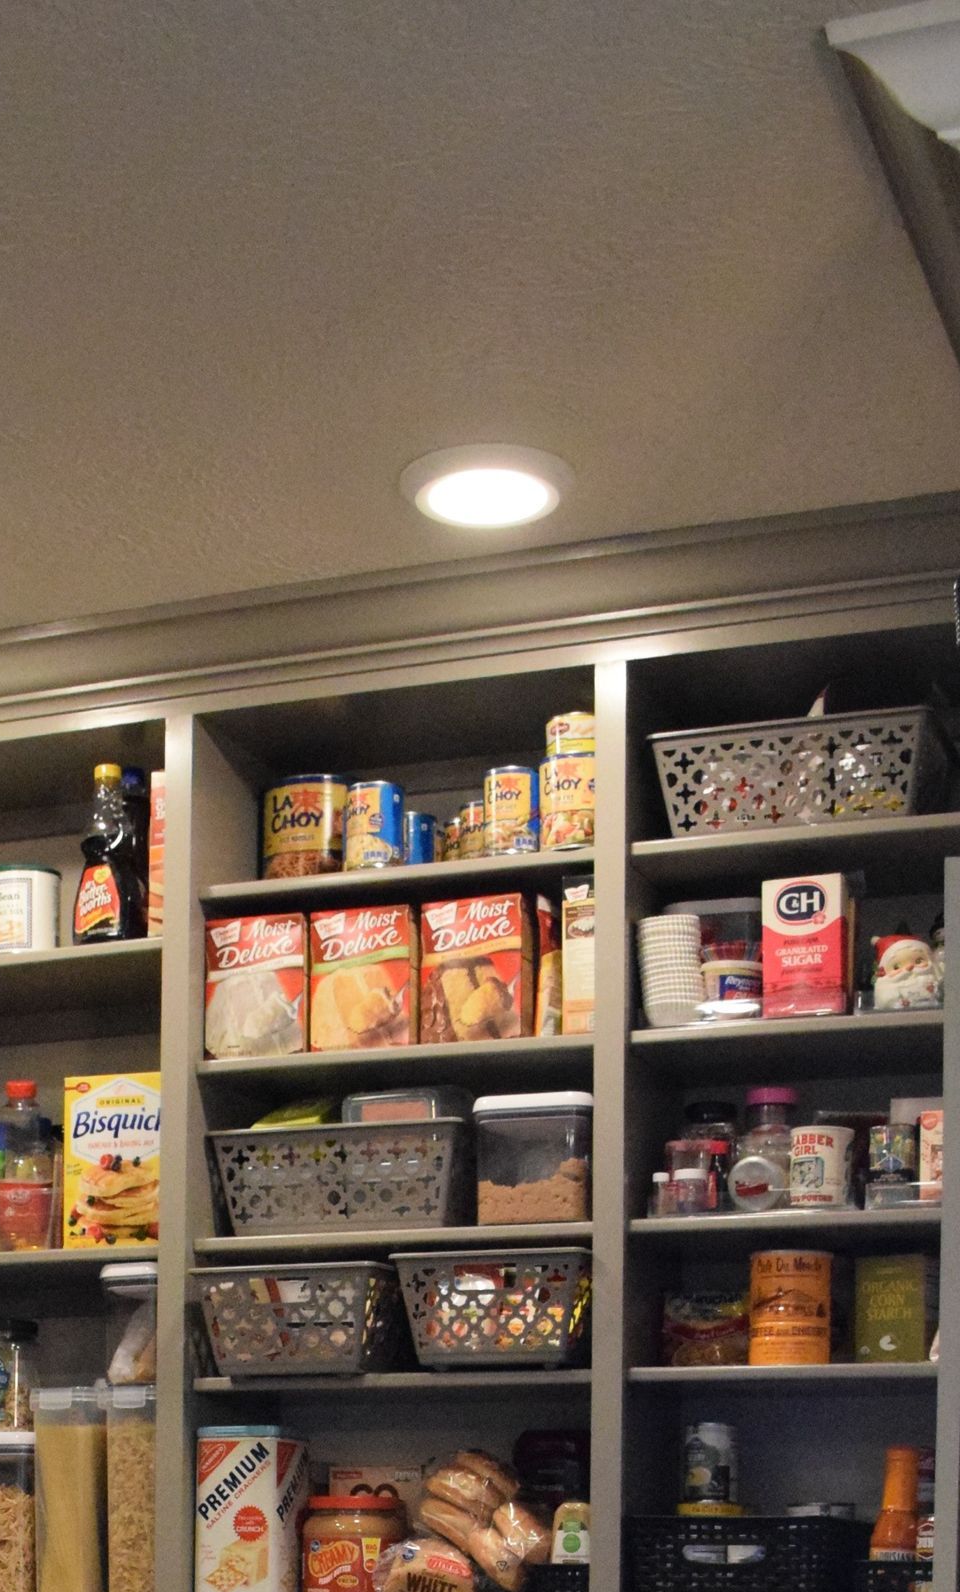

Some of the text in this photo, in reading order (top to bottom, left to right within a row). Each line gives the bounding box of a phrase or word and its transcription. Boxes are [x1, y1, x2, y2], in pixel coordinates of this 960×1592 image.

[272, 794, 293, 814] LA
[487, 790, 521, 805] CHOY
[271, 811, 323, 834] CHOY
[463, 901, 514, 923] Moist
[778, 891, 821, 915] C&H
[247, 919, 296, 942] Moist
[351, 911, 402, 933] Moist
[320, 927, 402, 961] Deluxe
[431, 917, 514, 952] Deluxe
[216, 936, 296, 968] Deluxe
[781, 956, 822, 968] SUGAR
[99, 1098, 142, 1106] ORIGINAL
[794, 1144, 818, 1157] GIRL
[197, 1441, 270, 1521] PREMIUM
[311, 1543, 358, 1575] CREAMY
